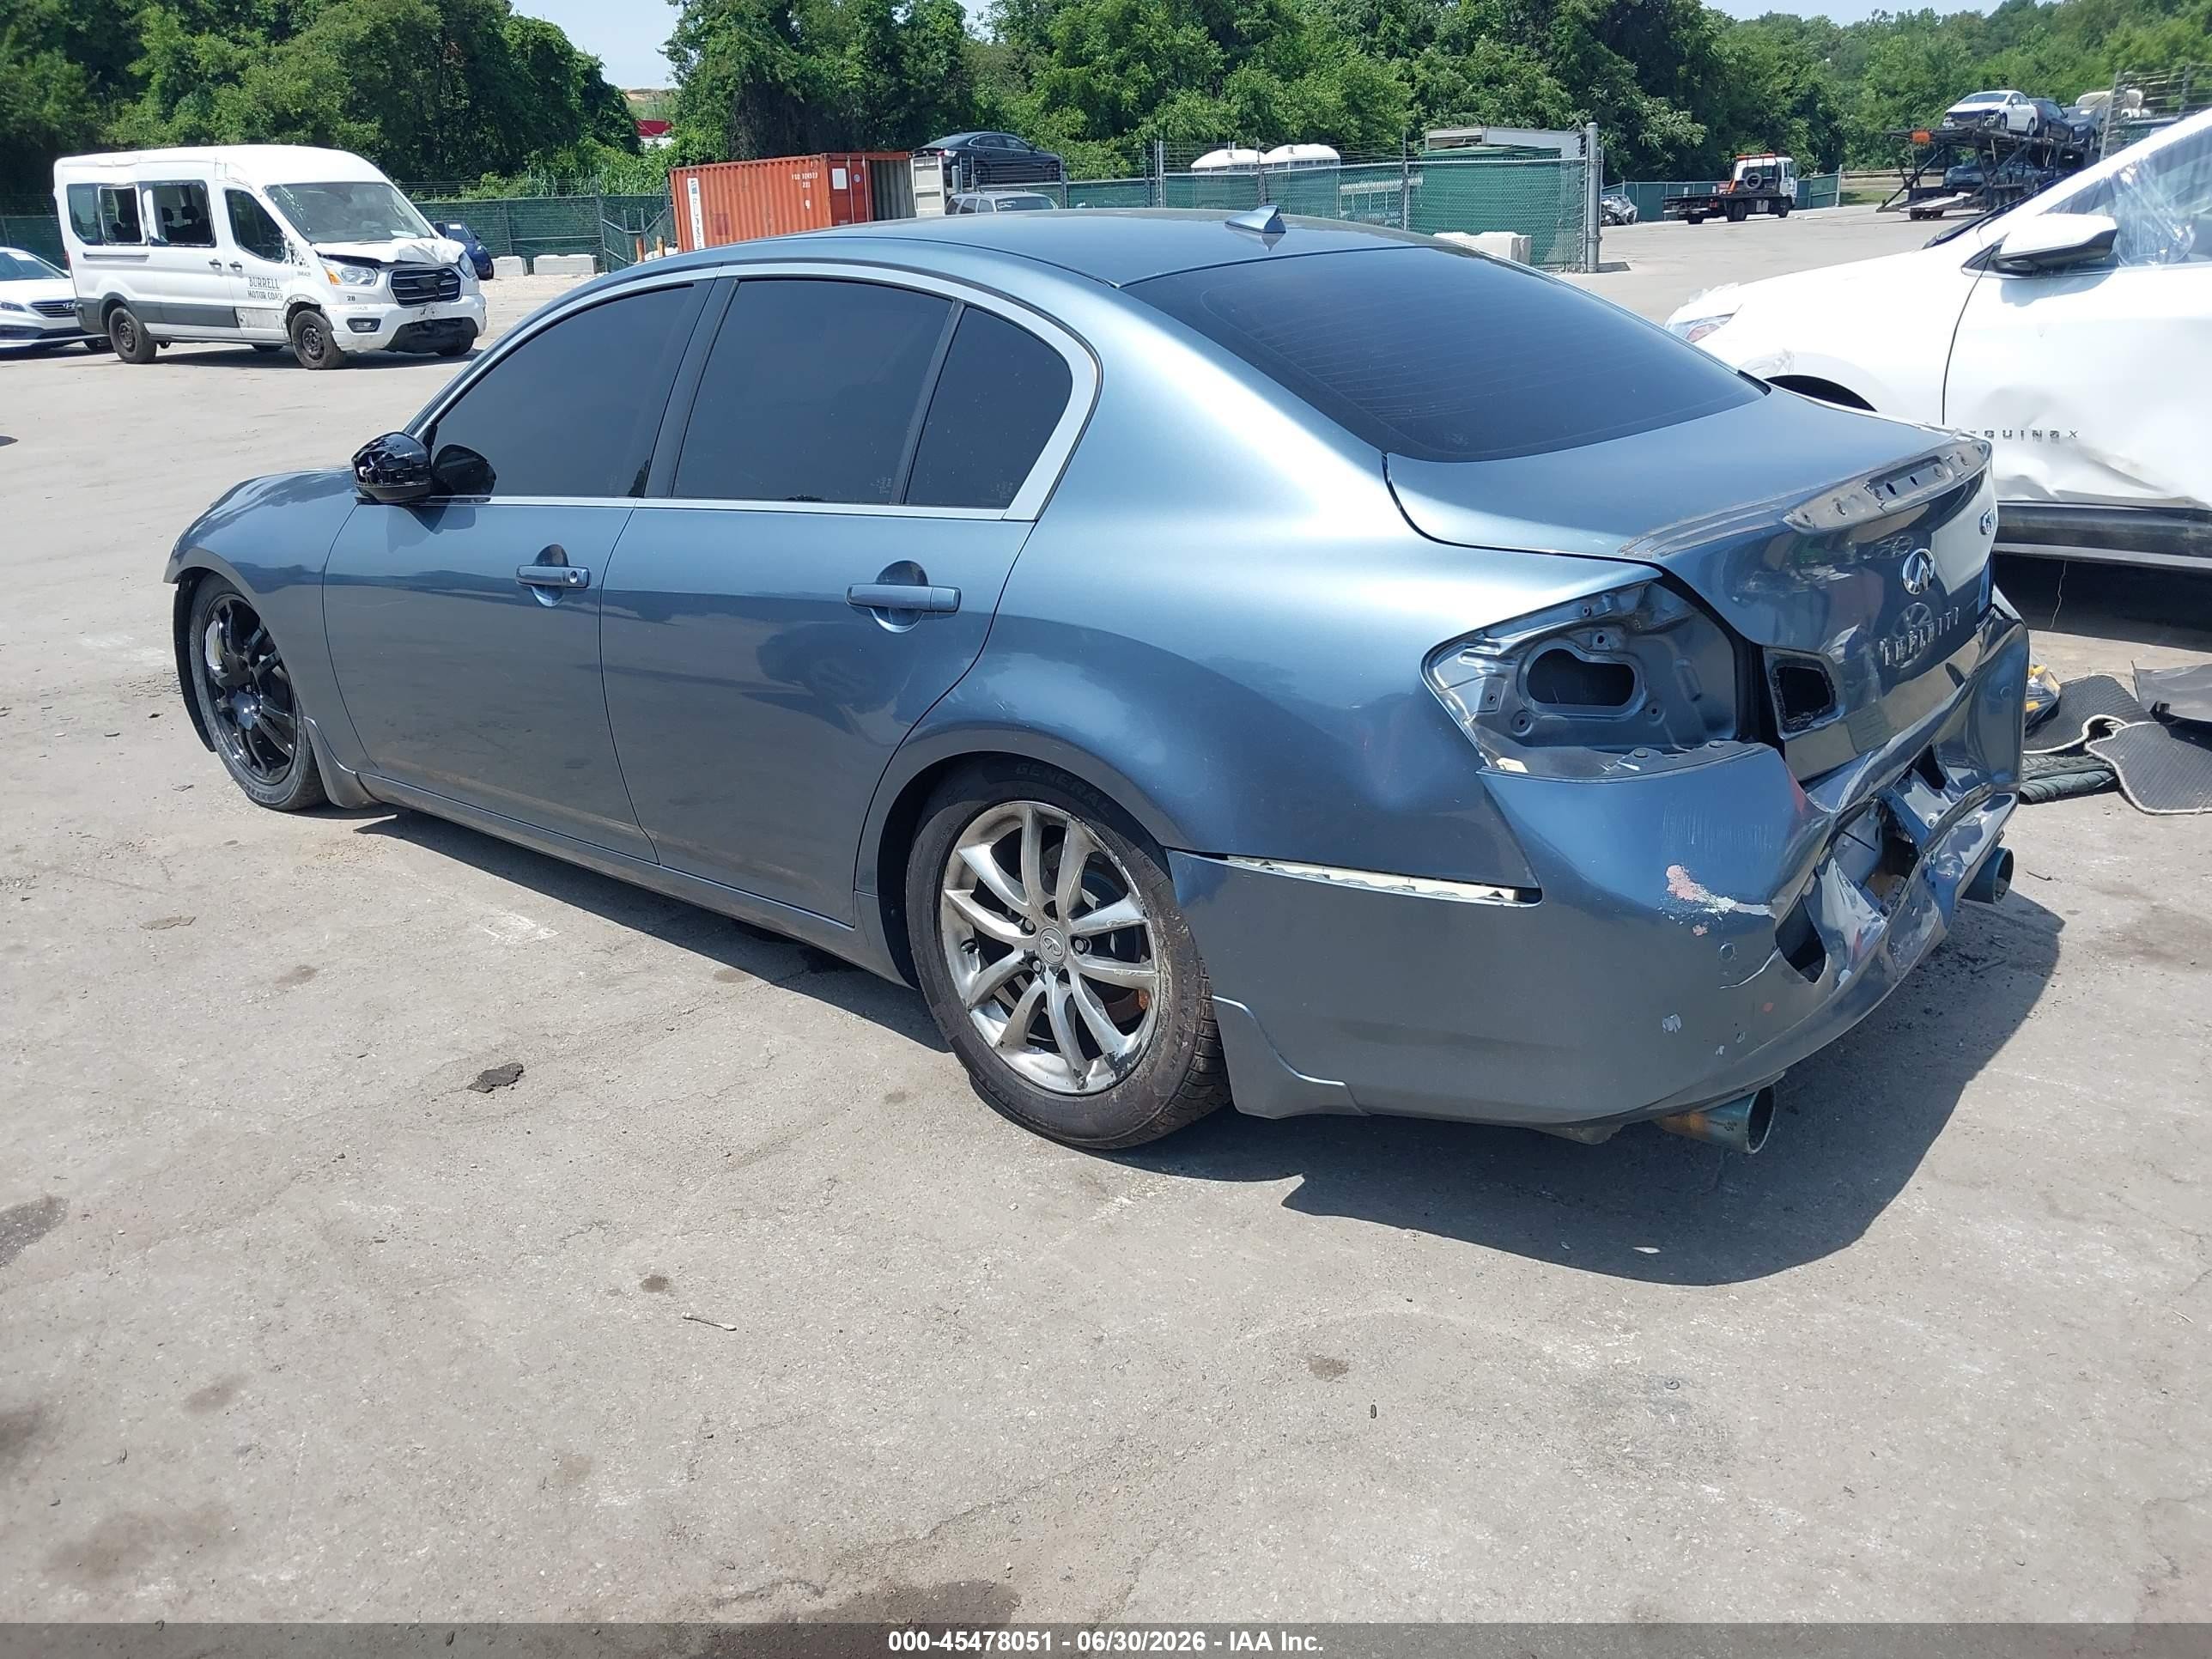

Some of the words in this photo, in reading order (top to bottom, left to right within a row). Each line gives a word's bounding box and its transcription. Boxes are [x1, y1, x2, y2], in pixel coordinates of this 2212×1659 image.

[249, 276, 280, 289] BURRELL
[247, 289, 266, 300] MOTOR
[267, 291, 283, 301] COACH
[1969, 429, 2078, 439] QUINOX
